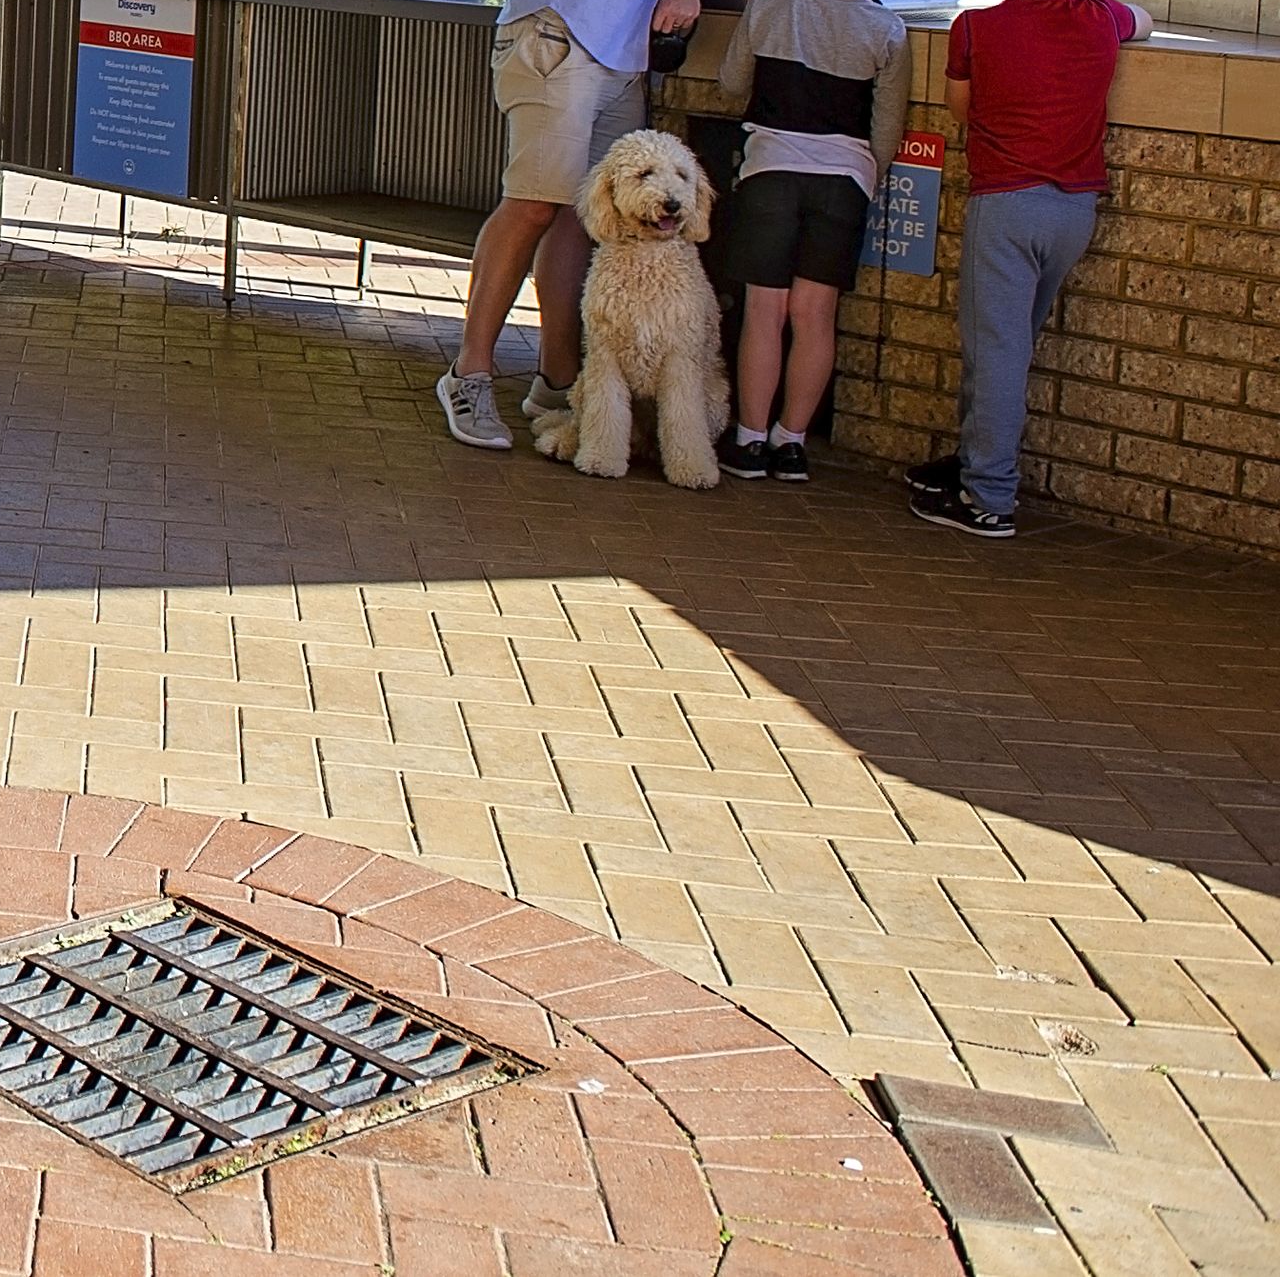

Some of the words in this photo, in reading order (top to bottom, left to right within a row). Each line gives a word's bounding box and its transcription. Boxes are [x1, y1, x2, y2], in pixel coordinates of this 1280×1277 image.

[109, 30, 131, 47] BBQ
[132, 33, 163, 49] AREA
[897, 140, 937, 159] TION
[902, 220, 925, 238] BE
[871, 236, 910, 257] HOT
